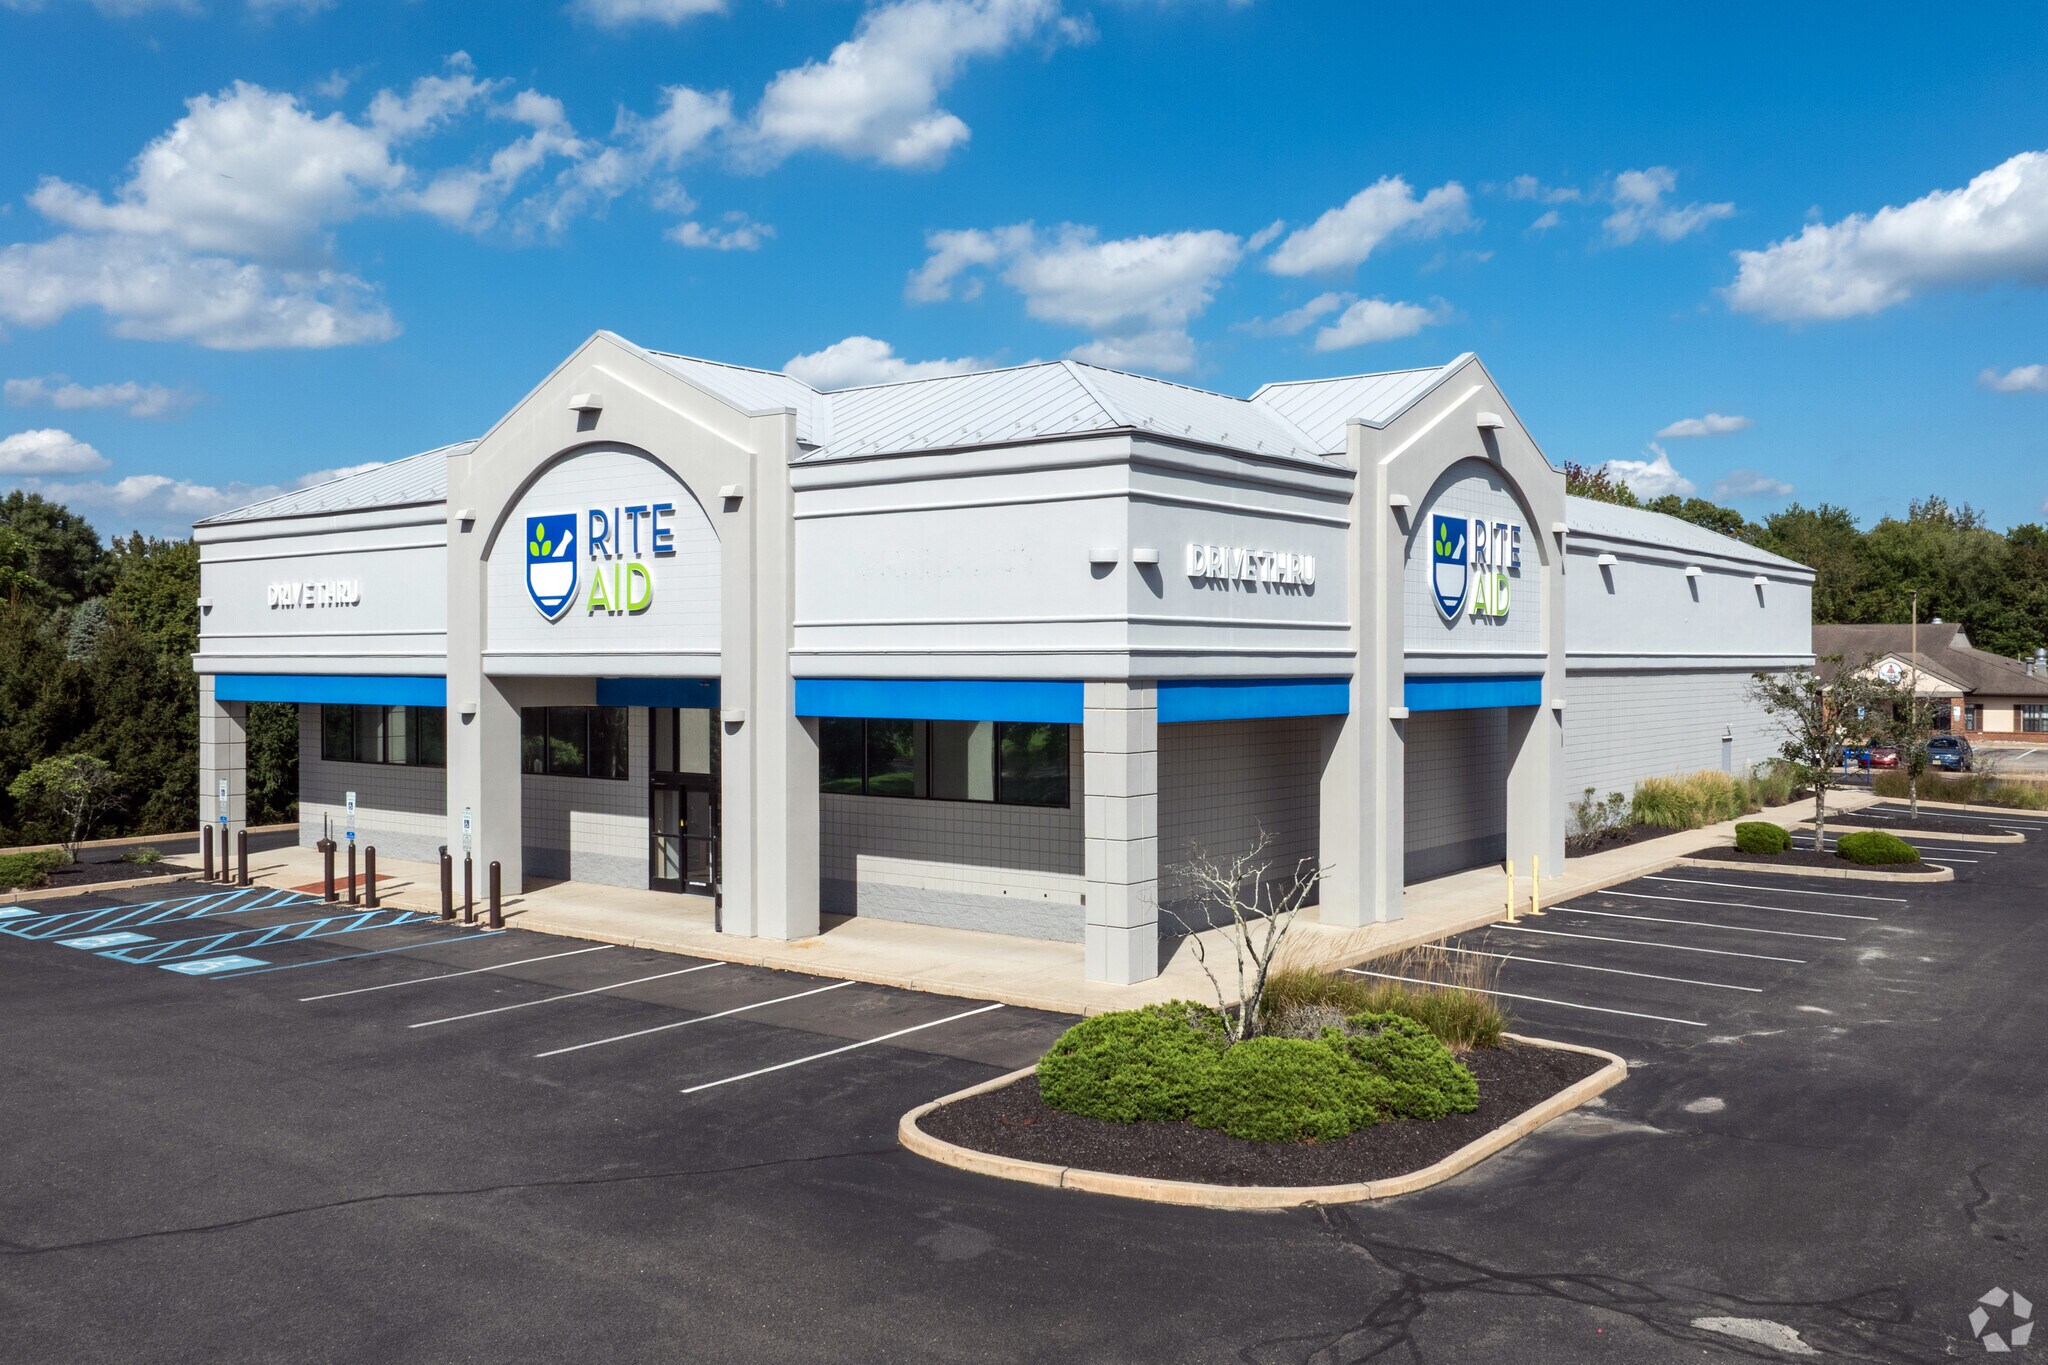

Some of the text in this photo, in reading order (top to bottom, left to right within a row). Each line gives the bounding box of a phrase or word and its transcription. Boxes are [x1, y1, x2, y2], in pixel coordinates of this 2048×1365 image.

[588, 502, 674, 556] RITE
[1473, 519, 1521, 568] RITE
[586, 562, 652, 612] AID
[1187, 544, 1316, 586] DRIVE THRU
[1472, 571, 1510, 616] AID
